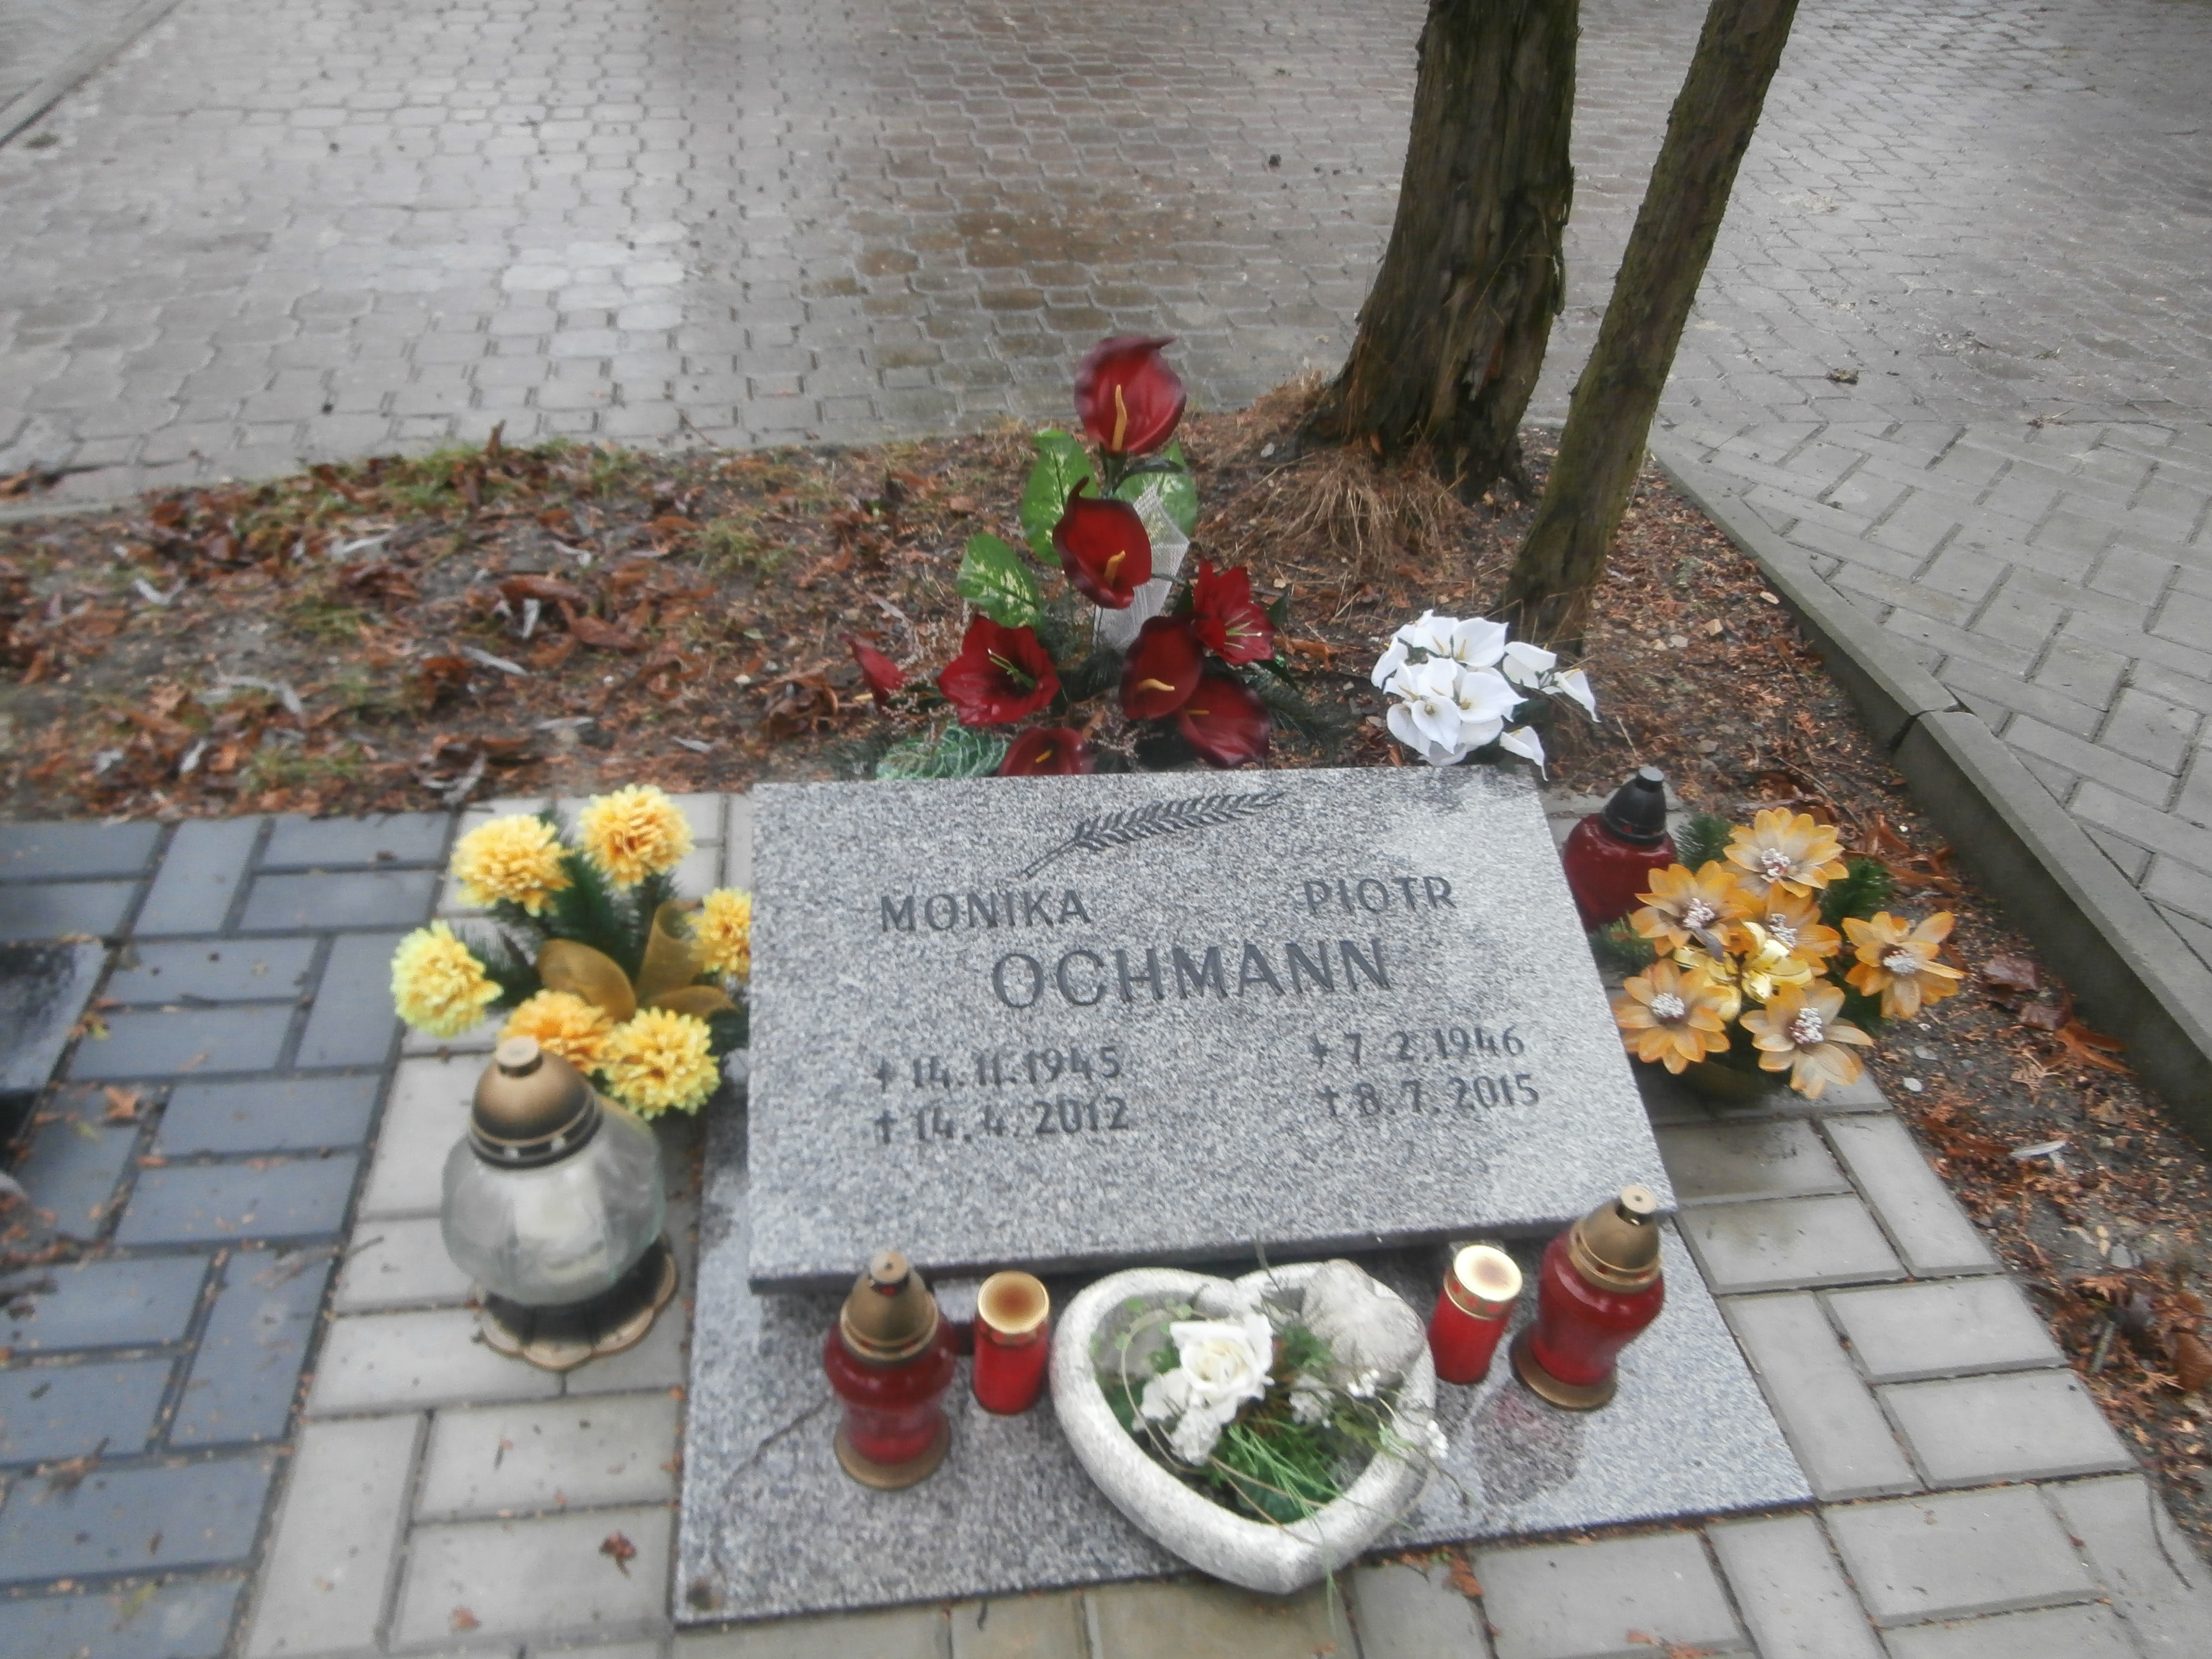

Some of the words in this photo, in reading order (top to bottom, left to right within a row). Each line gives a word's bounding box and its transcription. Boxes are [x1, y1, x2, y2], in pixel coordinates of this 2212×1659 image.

[880, 889, 1090, 932] MONIKA
[1303, 876, 1457, 914] PIOTR
[992, 938, 1391, 1008] OCHMANN
